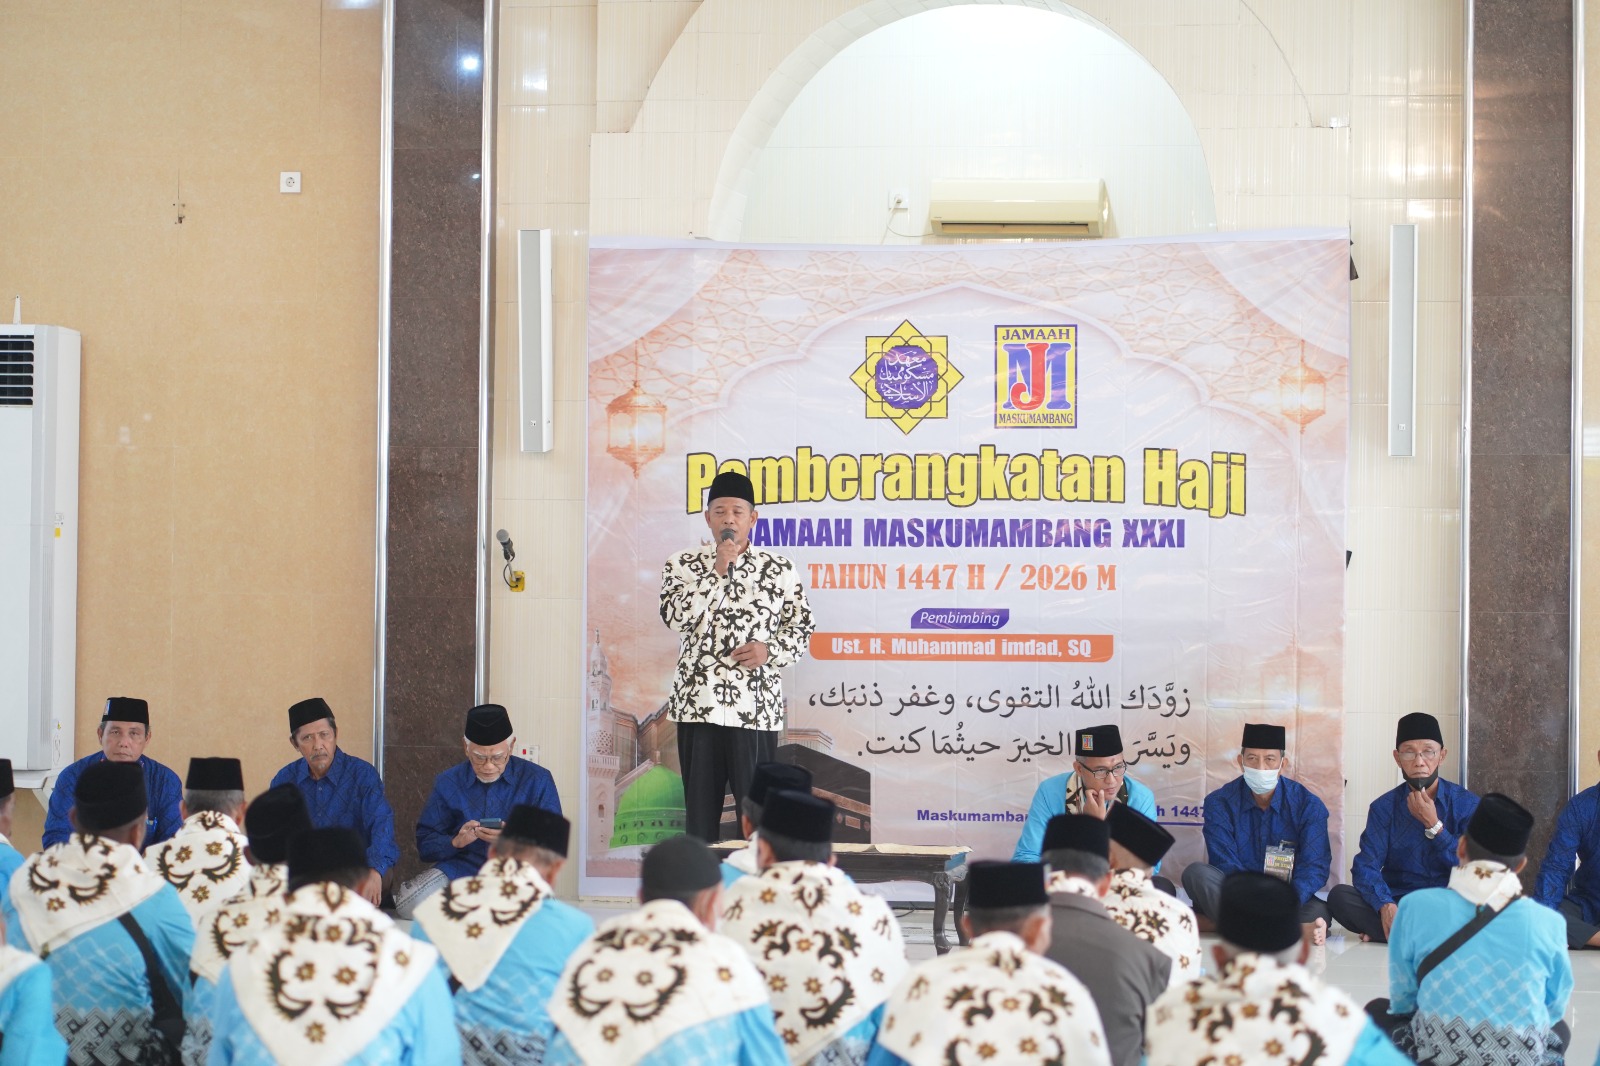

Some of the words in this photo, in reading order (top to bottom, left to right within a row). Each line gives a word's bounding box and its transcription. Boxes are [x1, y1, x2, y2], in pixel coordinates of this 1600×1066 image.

[1002, 328, 1071, 341] JAMAAH
[998, 412, 1073, 425] MASKUMAMBANG
[1143, 447, 1247, 518] Haji
[747, 518, 852, 547] AMAAH
[863, 518, 1112, 548] MASKUMAMBANG
[1122, 518, 1186, 548] XXXI
[807, 563, 887, 590] TAHUN
[895, 563, 958, 590] 1447
[966, 563, 985, 590] H
[994, 563, 1011, 591] /
[1020, 563, 1088, 591] 2026
[1096, 563, 1117, 591] M
[920, 611, 1000, 627] Pembimbing
[831, 637, 864, 654] Ust.
[869, 638, 886, 655] H.
[892, 638, 995, 656] Muhammad
[1001, 638, 1062, 658] imdad,
[1067, 639, 1092, 657] SQ
[889, 684, 955, 717] وغفر
